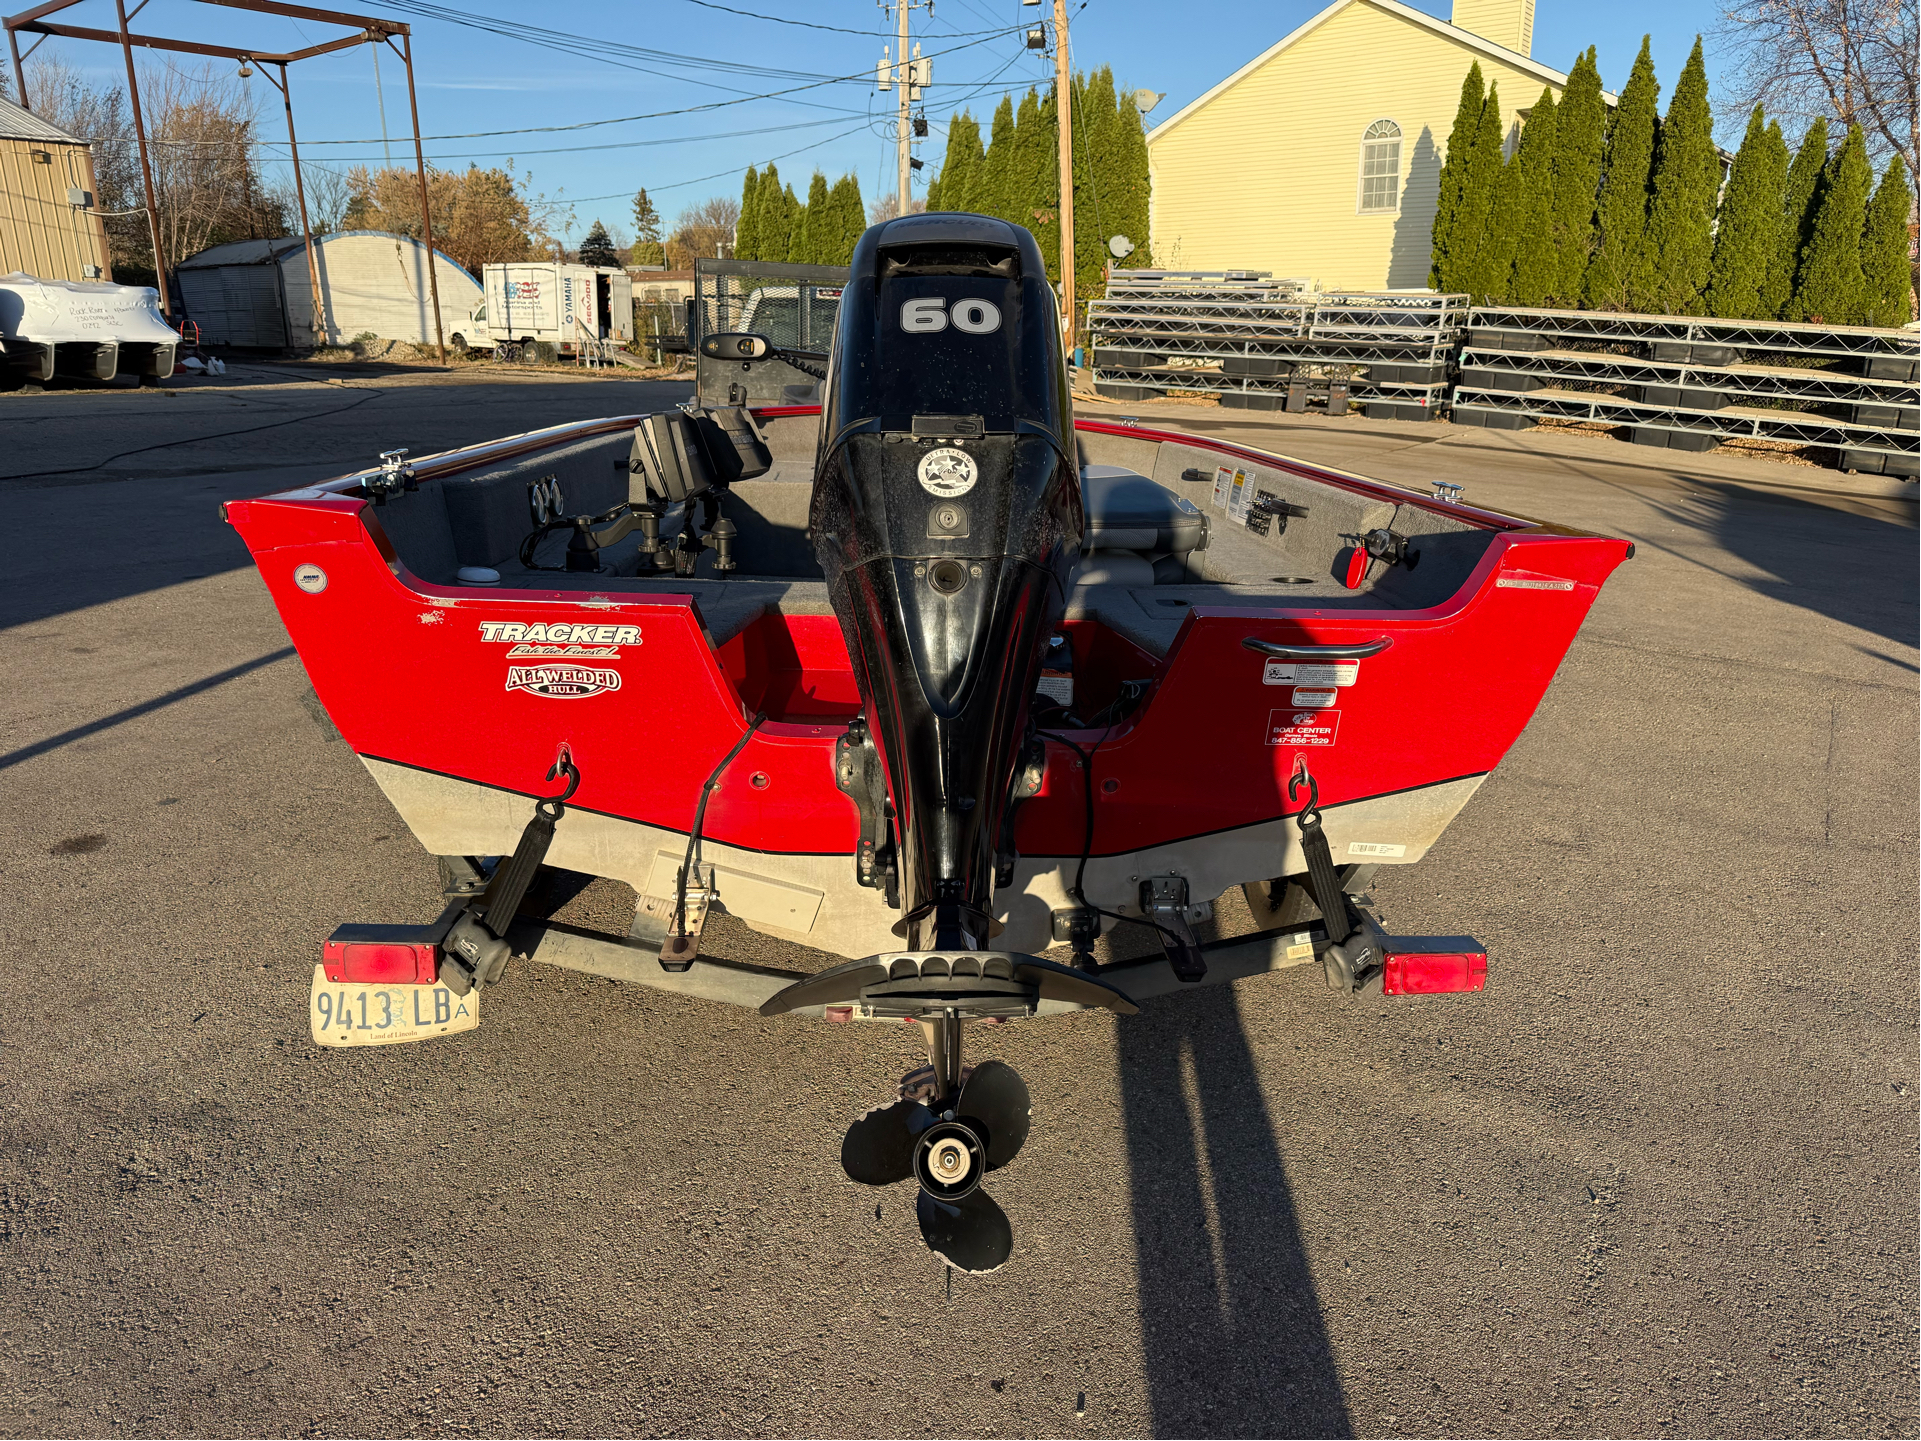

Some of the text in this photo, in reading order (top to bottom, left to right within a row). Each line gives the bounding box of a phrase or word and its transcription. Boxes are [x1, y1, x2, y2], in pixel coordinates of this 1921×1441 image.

[893, 219, 998, 229] MERCURY
[564, 277, 573, 313] YAMAHA
[901, 297, 1002, 334] 60
[925, 449, 973, 464] ULTRA LOW
[479, 621, 640, 645] TRACKER
[512, 646, 541, 655] Fish
[541, 645, 561, 655] the
[508, 667, 620, 690] ALL WELDED
[547, 685, 581, 694] HULL
[318, 988, 470, 1031] 9413 LB A
[395, 1030, 418, 1038] Lincoln
